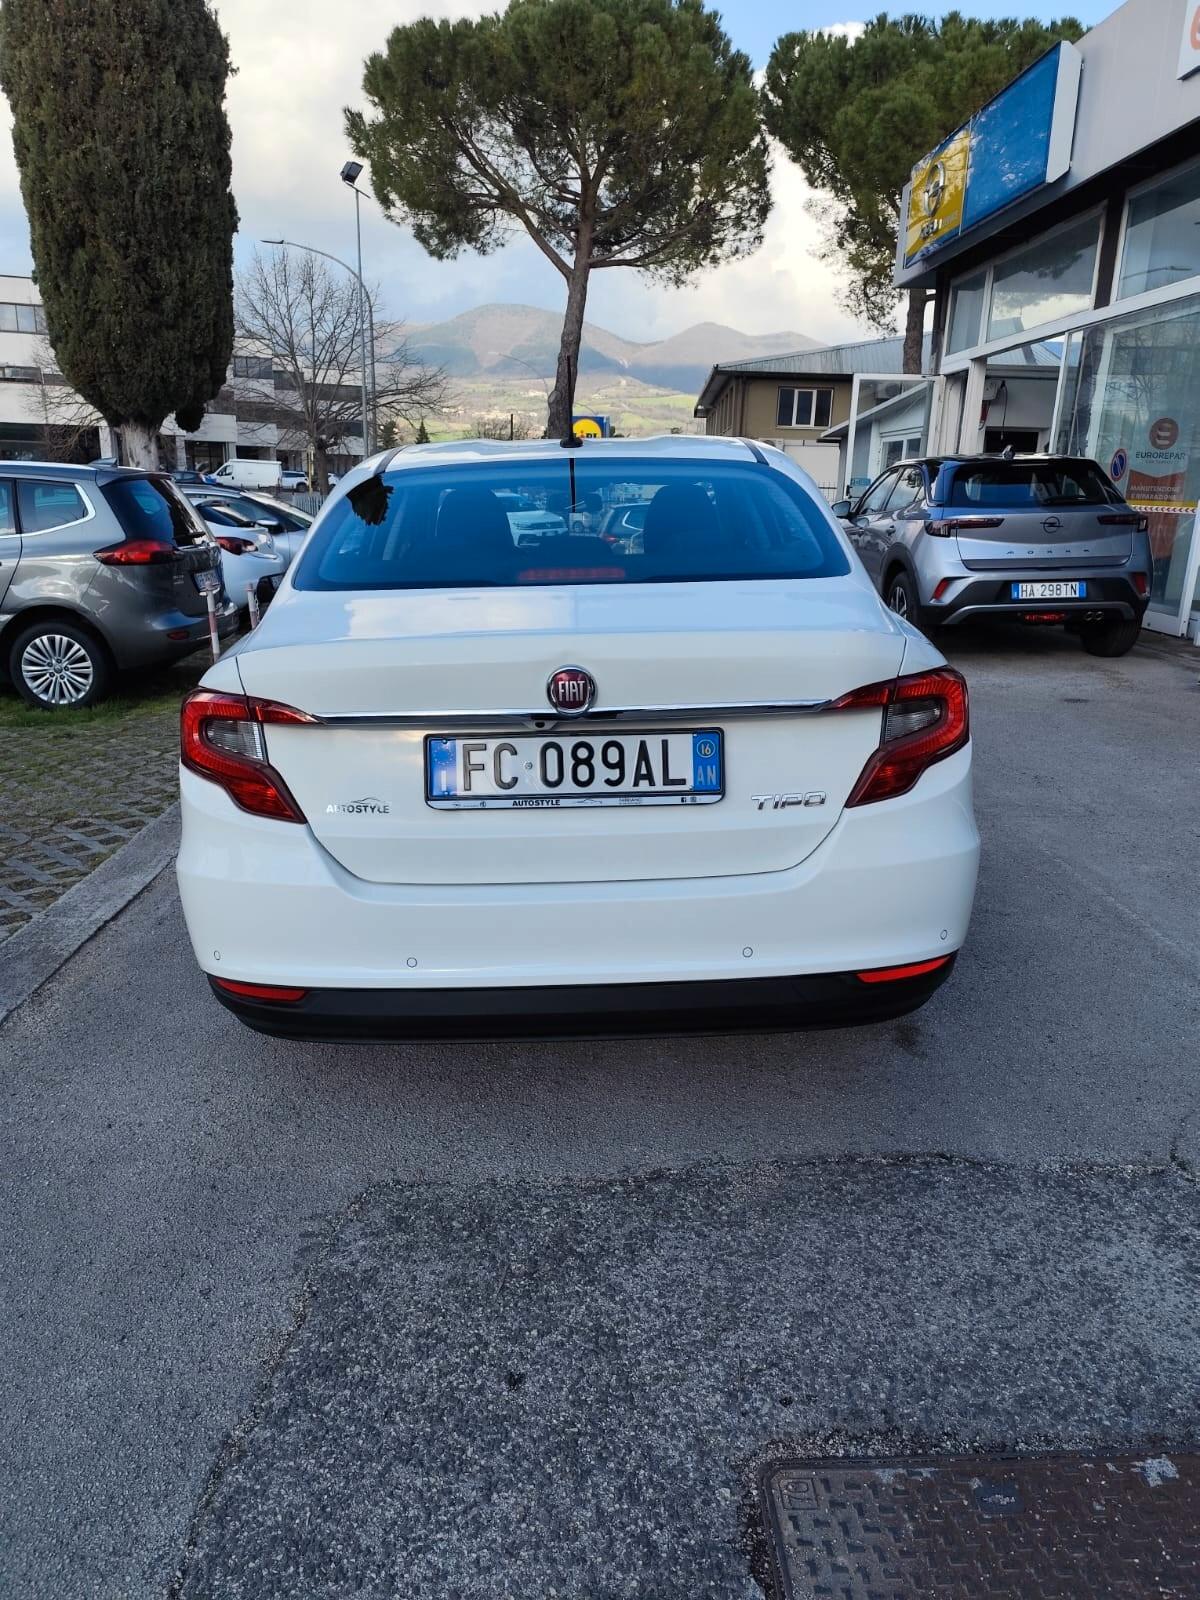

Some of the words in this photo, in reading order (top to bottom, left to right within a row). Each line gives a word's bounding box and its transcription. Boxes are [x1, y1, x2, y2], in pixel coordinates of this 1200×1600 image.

[1135, 451, 1186, 460] EUROREPAR
[1020, 584, 1035, 598] HA
[1040, 583, 1077, 597] 298TN
[558, 680, 585, 701] FIAT
[700, 743, 712, 756] 16
[462, 742, 518, 791] FC
[539, 739, 687, 788] 089AL
[696, 764, 717, 786] AN
[512, 799, 561, 807] AUTOSTYLE
[751, 791, 826, 810] TIPO
[326, 804, 390, 814] AUTOSTYLE
